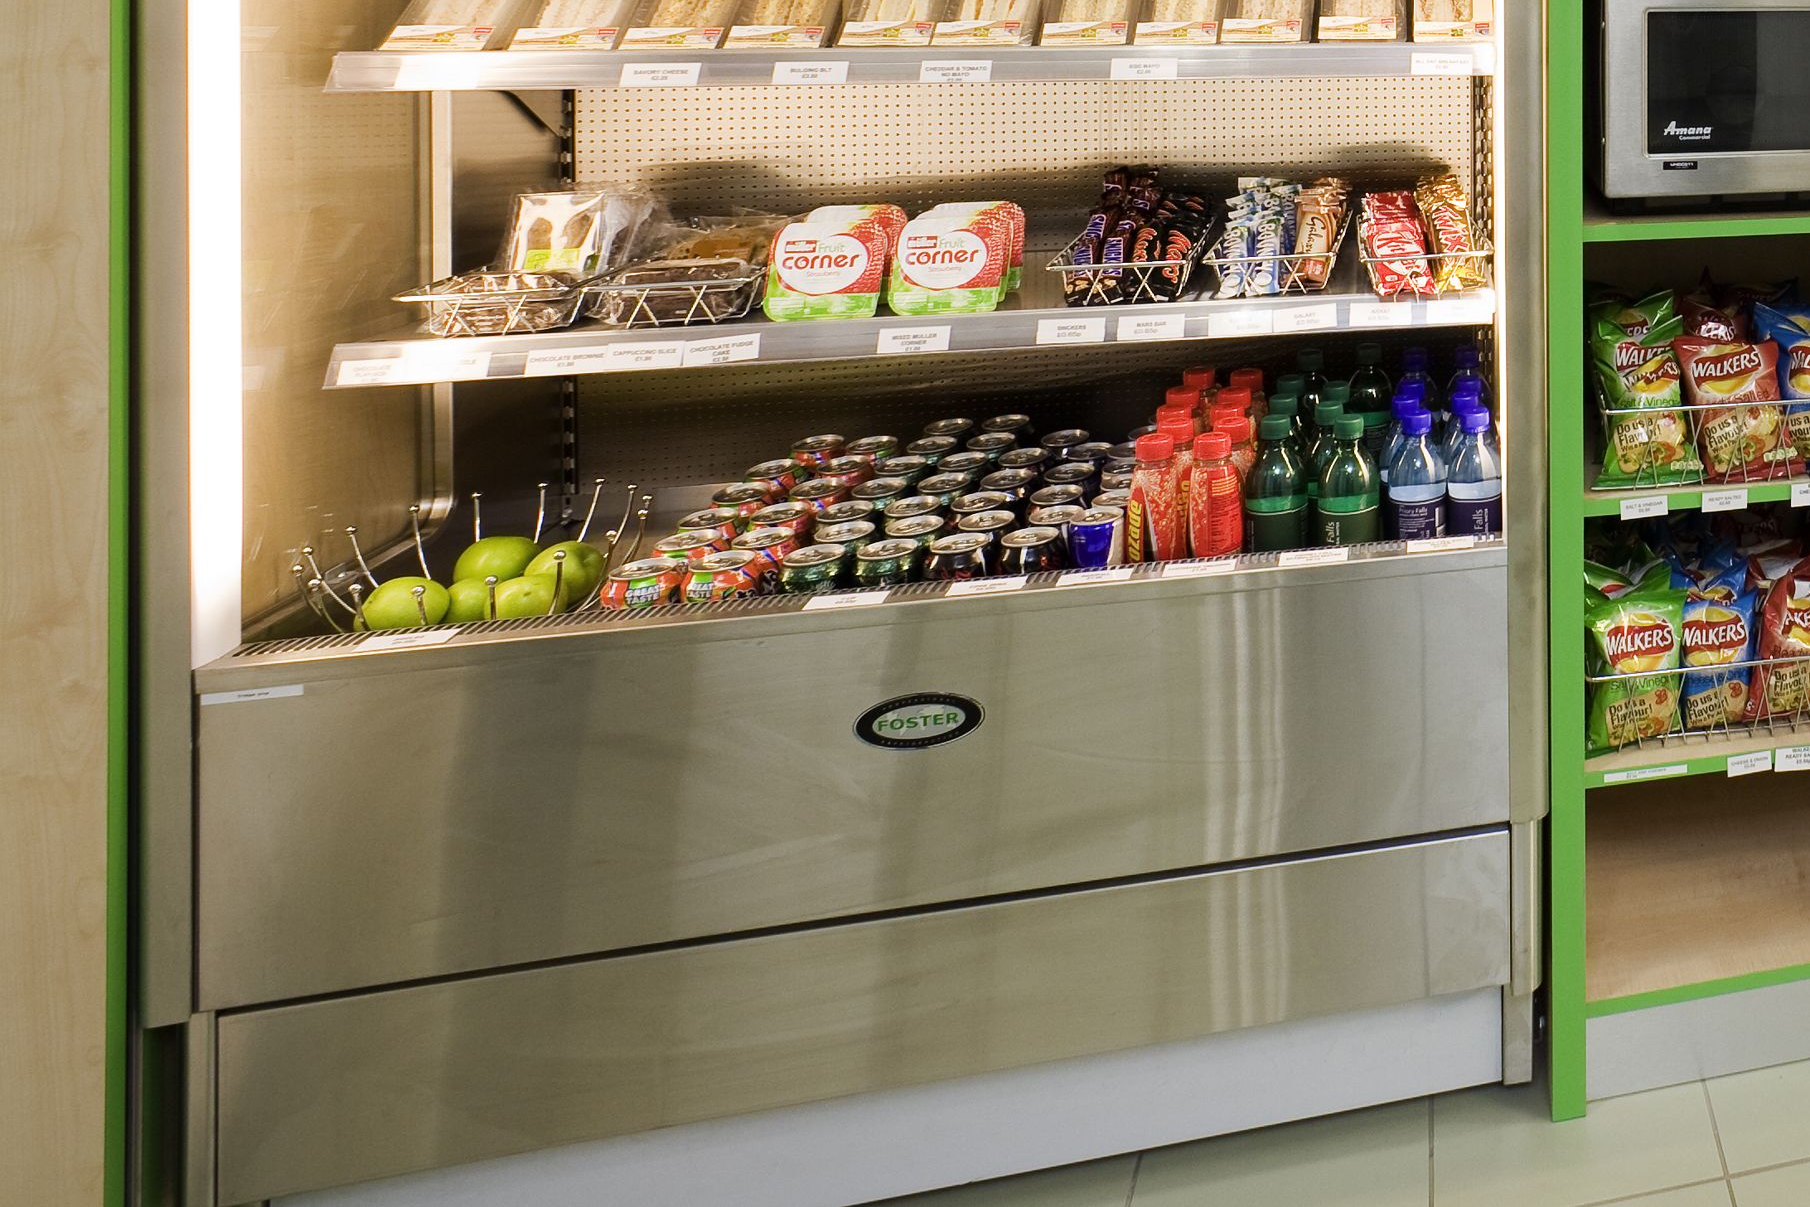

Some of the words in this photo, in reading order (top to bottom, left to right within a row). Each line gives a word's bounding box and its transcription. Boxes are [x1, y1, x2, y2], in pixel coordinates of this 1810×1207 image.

[1663, 120, 1712, 136] Amana
[1432, 206, 1470, 253] TWIX
[818, 242, 845, 253] Fruit
[939, 239, 965, 249] Fruit
[782, 254, 860, 270] corner
[907, 250, 978, 266] corner
[690, 343, 731, 353] CHOCOLATE
[1692, 350, 1760, 378] WALKERS
[1705, 425, 1718, 437] Do
[1718, 421, 1731, 432] us
[1791, 416, 1802, 426] us
[1616, 423, 1631, 436] Do
[1472, 509, 1484, 531] Falls
[1326, 522, 1335, 543] Falls
[625, 584, 662, 598] GREAT
[627, 593, 660, 605] TASTE
[1607, 627, 1673, 656] WALKERS
[1683, 622, 1746, 647] WALKERS
[1774, 670, 1789, 682] Do
[1686, 697, 1699, 709] Do
[1699, 692, 1713, 704] us
[1609, 705, 1623, 717] Do
[877, 712, 959, 732] FOSTER
